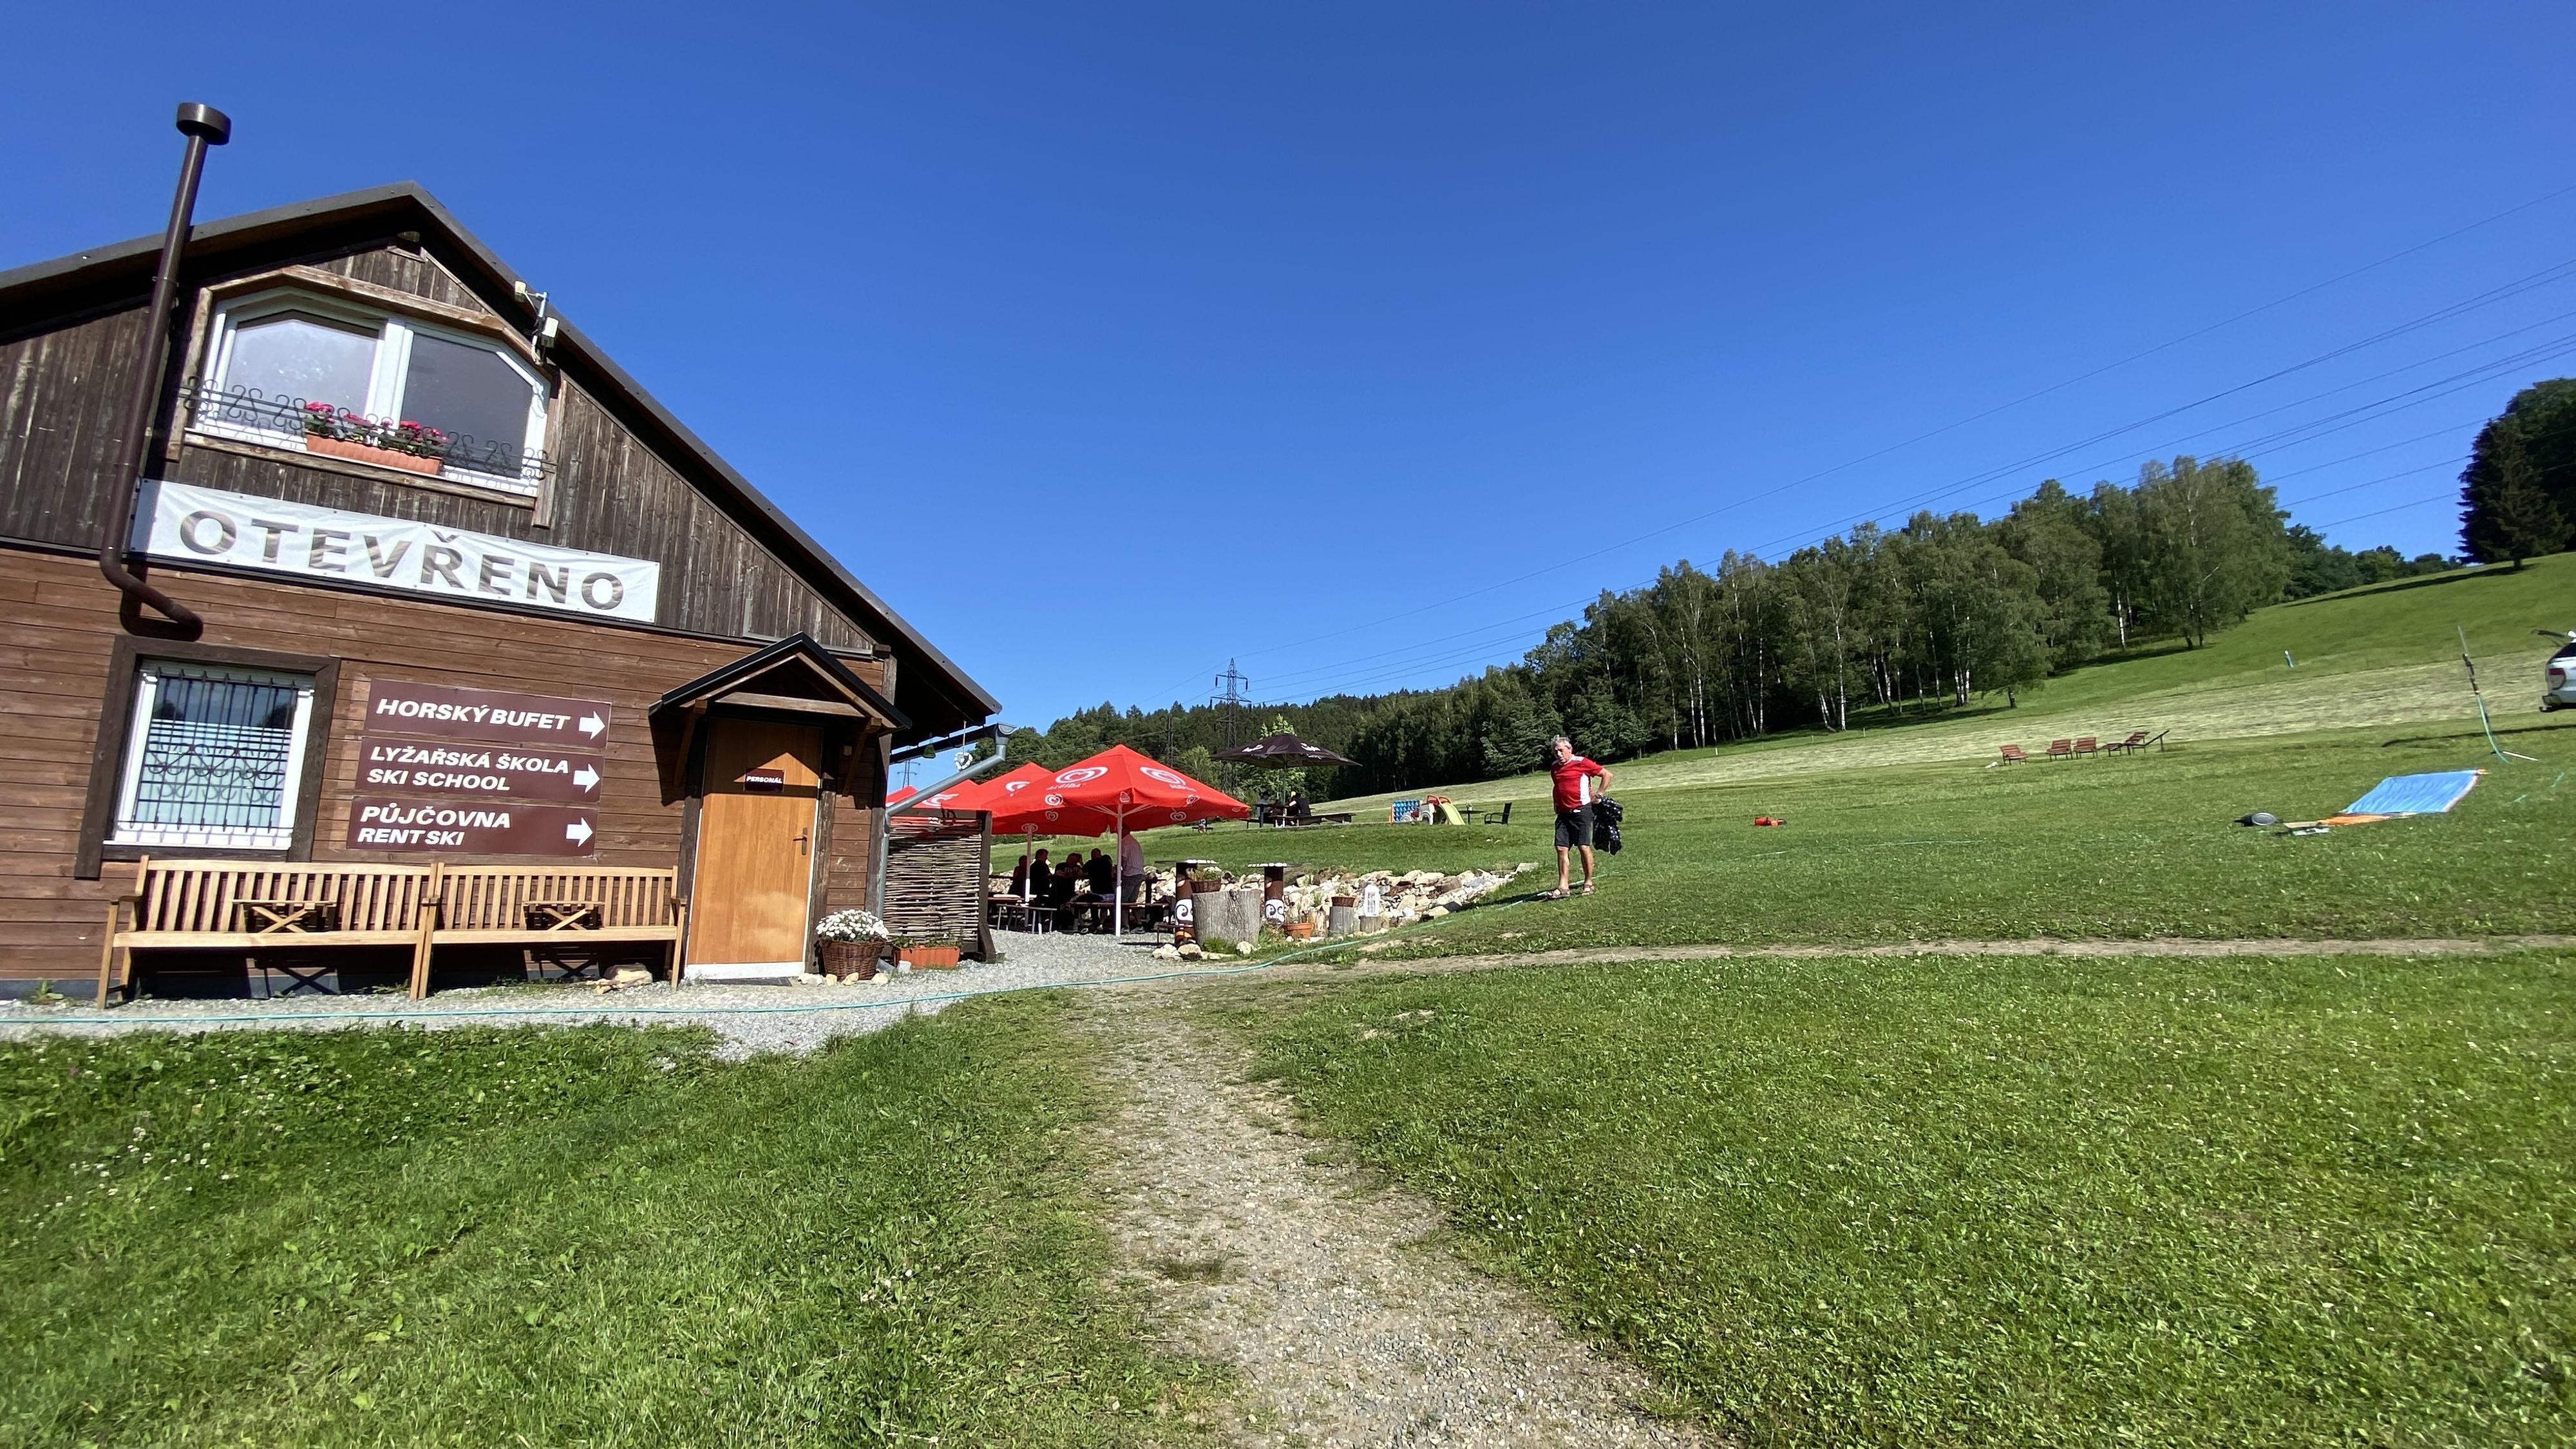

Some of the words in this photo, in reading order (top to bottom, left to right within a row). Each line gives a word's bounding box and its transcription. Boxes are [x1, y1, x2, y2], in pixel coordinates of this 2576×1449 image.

[180, 510, 624, 611] OTEVŘENO
[375, 698, 491, 723] HORSKÝ
[489, 708, 571, 730] BUFET
[370, 745, 491, 768] LYŽAŘSKÁ
[495, 752, 569, 774] ŠKOLA
[366, 768, 409, 784] SKI
[412, 772, 510, 791] SCHOOL
[360, 802, 511, 828] PŮJČOVNA
[357, 828, 426, 844] RENT
[425, 830, 465, 846] SKI
